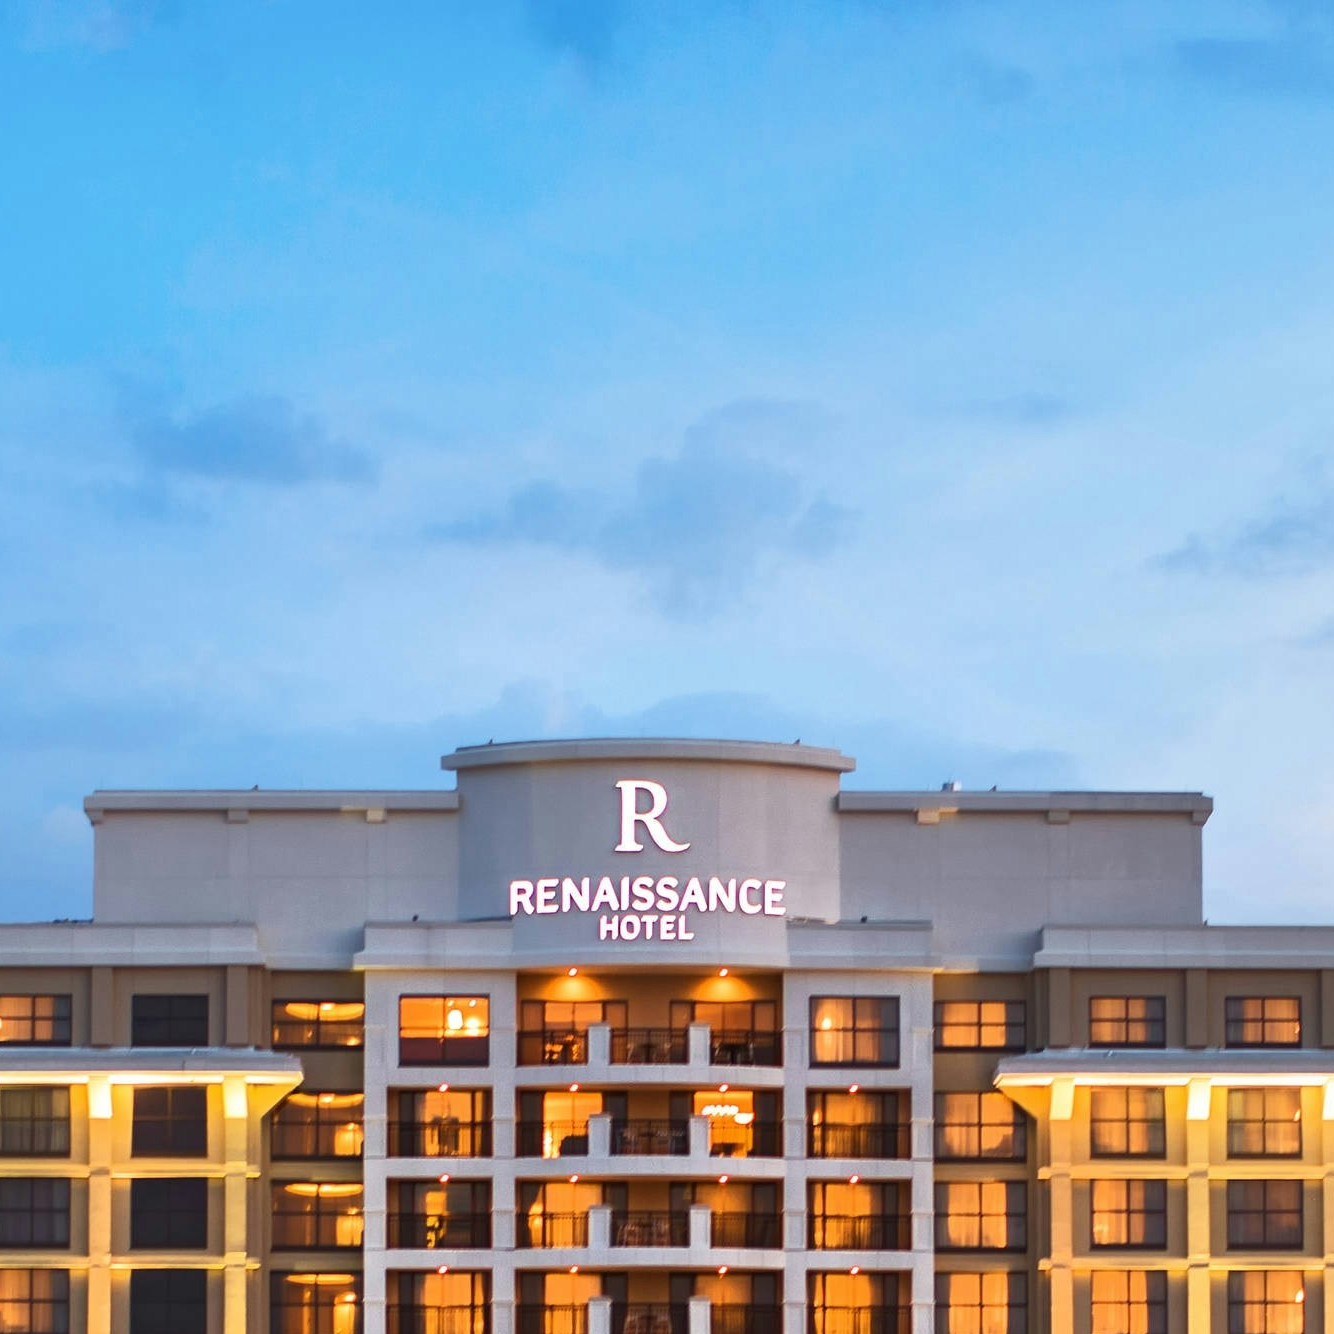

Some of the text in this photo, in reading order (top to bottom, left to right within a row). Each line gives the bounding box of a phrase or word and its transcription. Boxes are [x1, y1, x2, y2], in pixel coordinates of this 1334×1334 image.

[614, 779, 691, 853] R
[509, 876, 787, 916] RENAISSANCE
[599, 914, 695, 941] HOTEL
